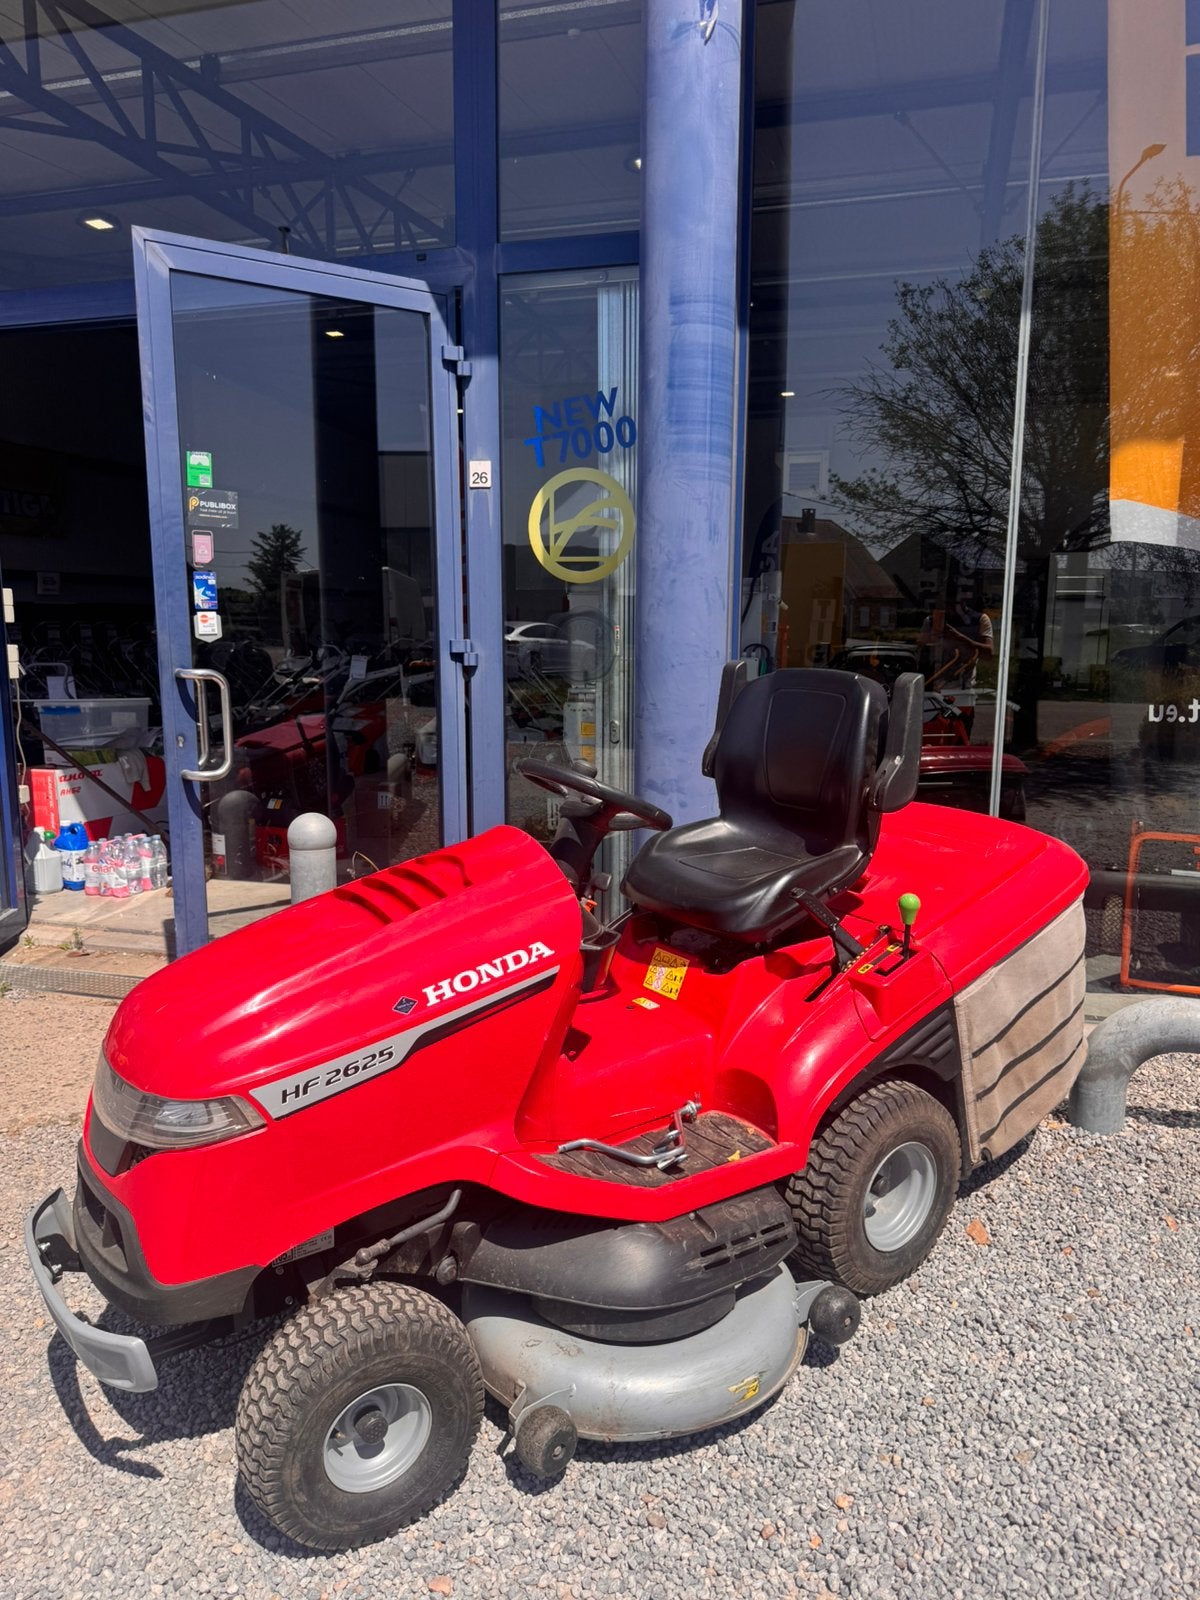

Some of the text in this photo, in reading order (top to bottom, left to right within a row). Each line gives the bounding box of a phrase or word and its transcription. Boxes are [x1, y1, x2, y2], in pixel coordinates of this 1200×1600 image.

[533, 387, 619, 434] NEW
[471, 471, 489, 485] 26
[200, 500, 237, 511] PUBLIBOX
[422, 941, 555, 1007] HONDA
[280, 1045, 396, 1105] HF 2625
